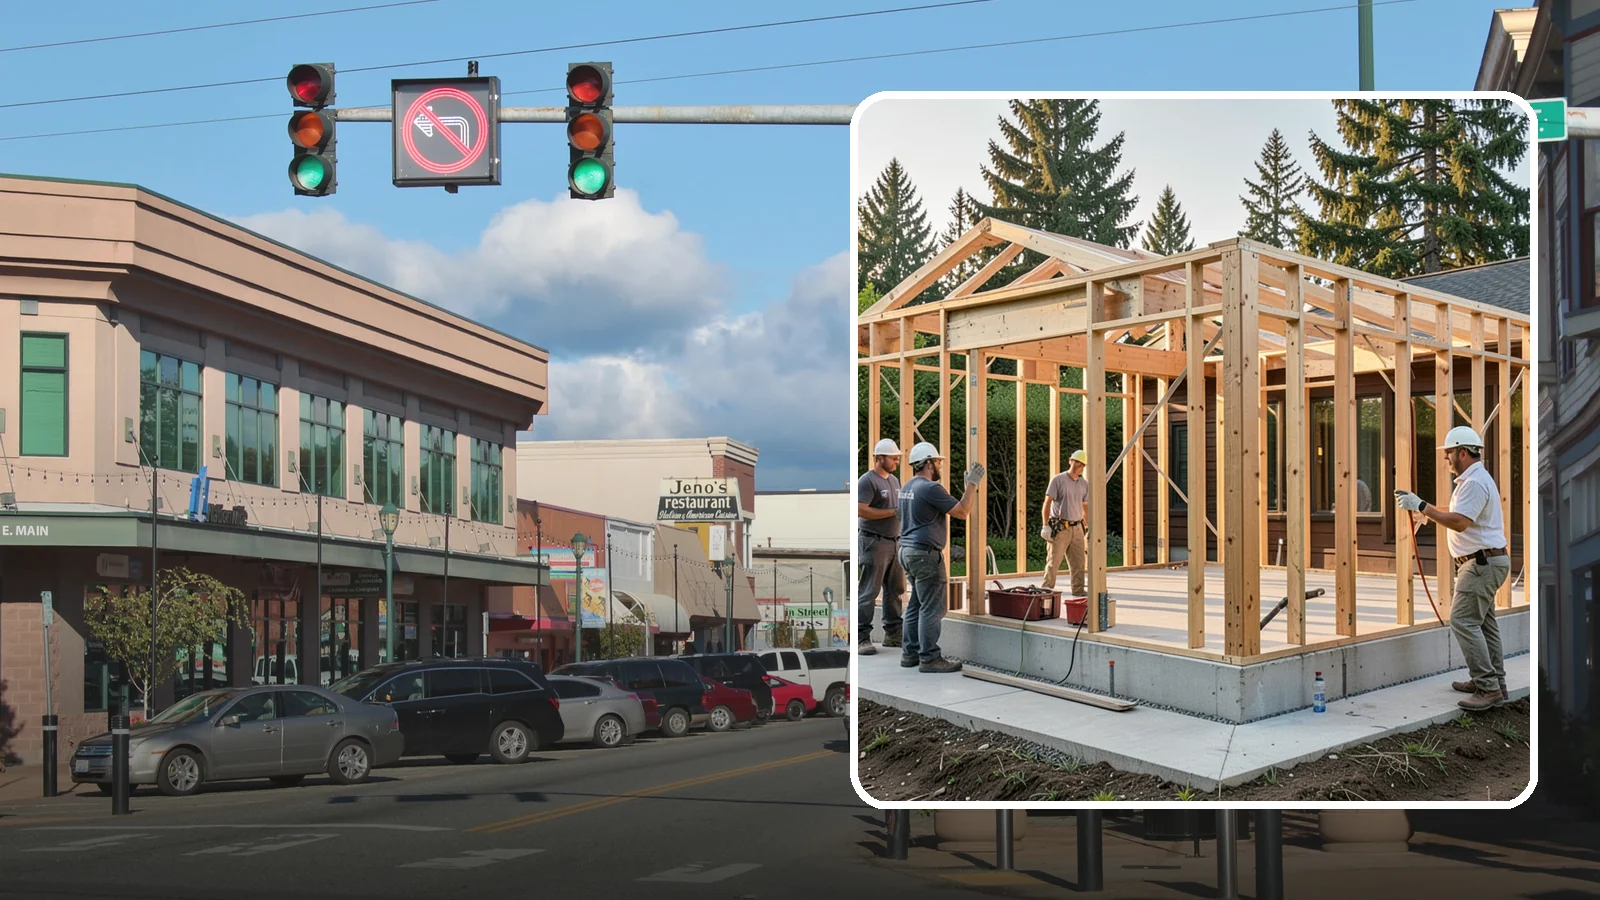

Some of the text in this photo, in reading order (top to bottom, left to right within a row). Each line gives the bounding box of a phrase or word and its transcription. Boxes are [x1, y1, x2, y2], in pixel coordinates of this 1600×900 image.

[669, 480, 728, 495] Jeno's
[665, 496, 731, 509] restaurant
[658, 510, 682, 520] Italian
[686, 509, 715, 519] American
[714, 509, 737, 519] Cuisine
[2, 525, 49, 536] E. MAIN
[797, 607, 828, 617] Street
